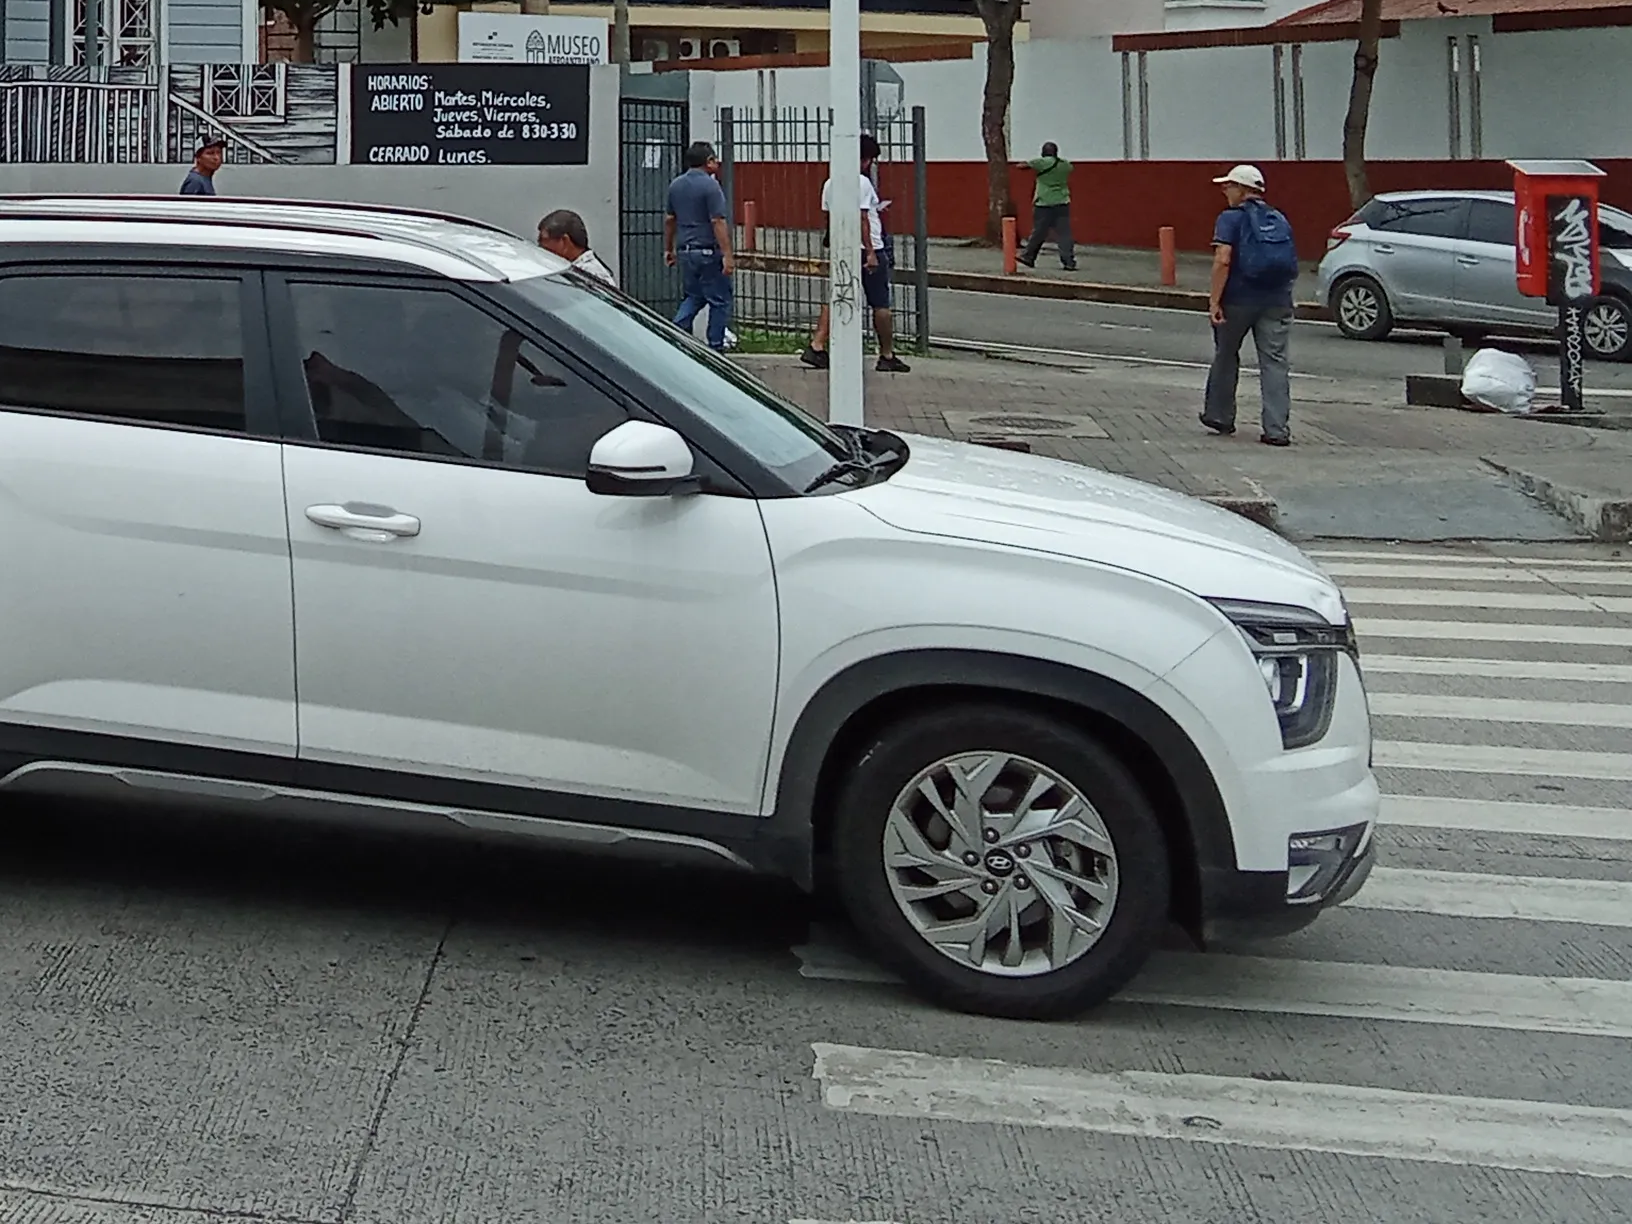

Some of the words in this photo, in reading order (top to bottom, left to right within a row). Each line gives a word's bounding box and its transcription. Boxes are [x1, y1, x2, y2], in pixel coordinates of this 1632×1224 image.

[547, 34, 600, 56] MUSEO
[367, 75, 434, 91] HORARIOS:
[371, 94, 424, 111] ABIERTO
[435, 124, 491, 139] Sábado
[497, 125, 515, 139] de
[369, 146, 430, 162] CERRADO
[438, 149, 492, 164] Lunes.
